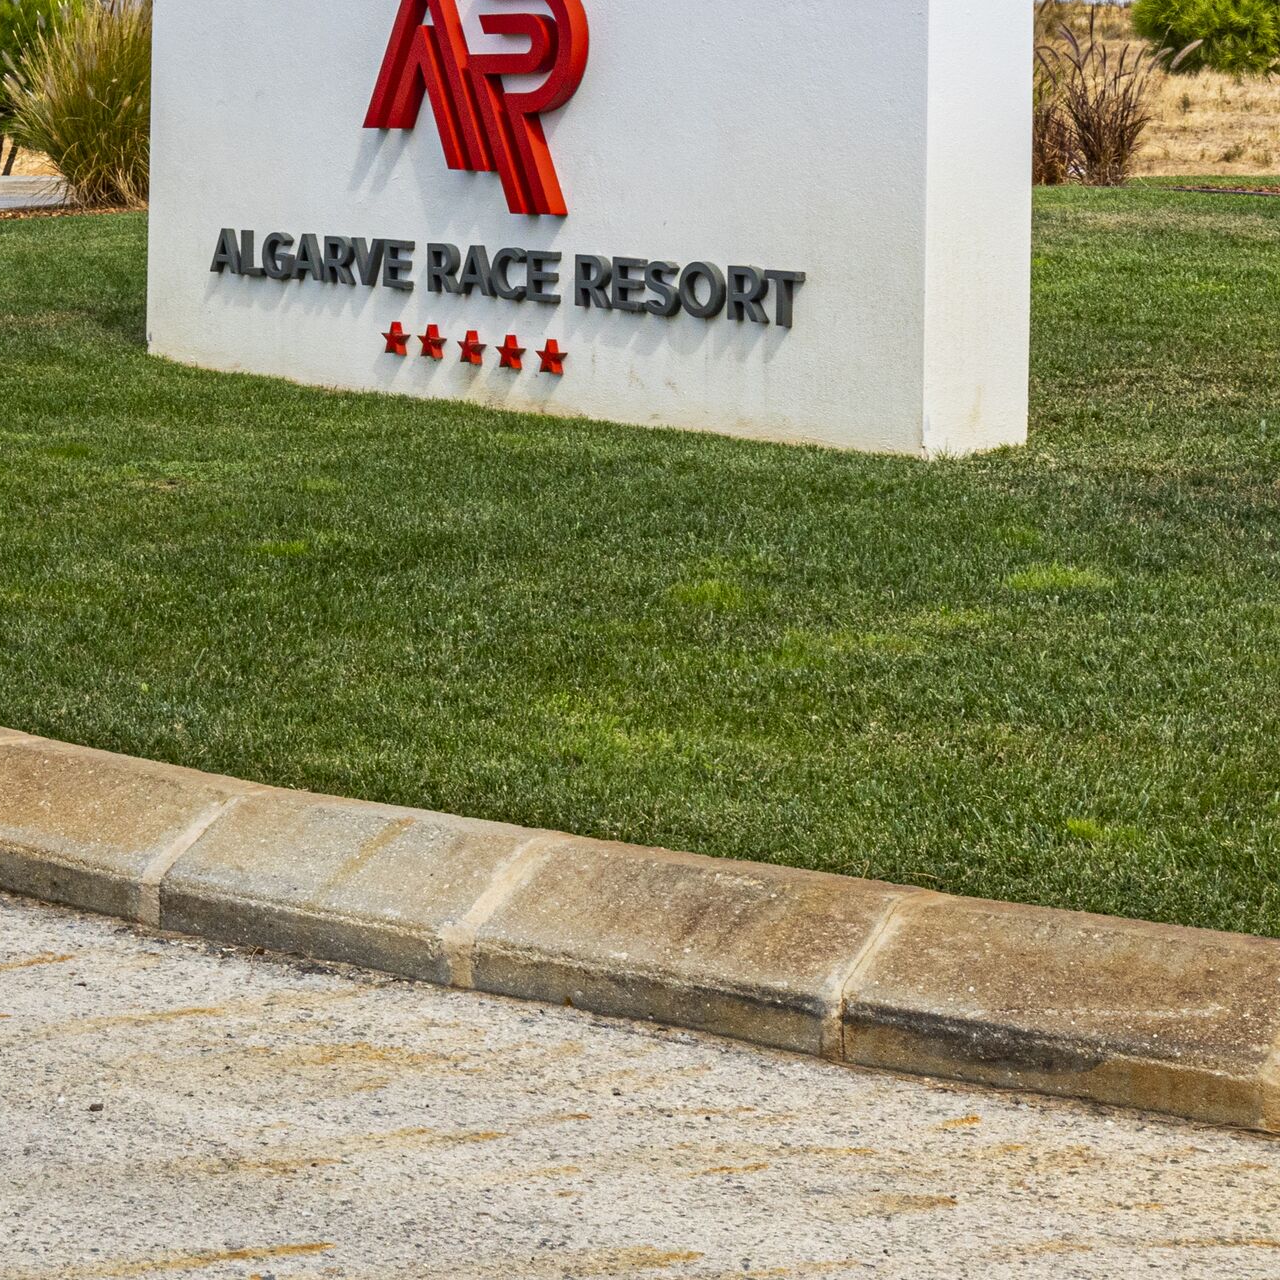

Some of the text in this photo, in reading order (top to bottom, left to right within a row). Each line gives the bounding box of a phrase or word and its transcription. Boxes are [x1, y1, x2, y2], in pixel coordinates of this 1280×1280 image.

[210, 228, 806, 328] ALGARVE RACE RESORT
